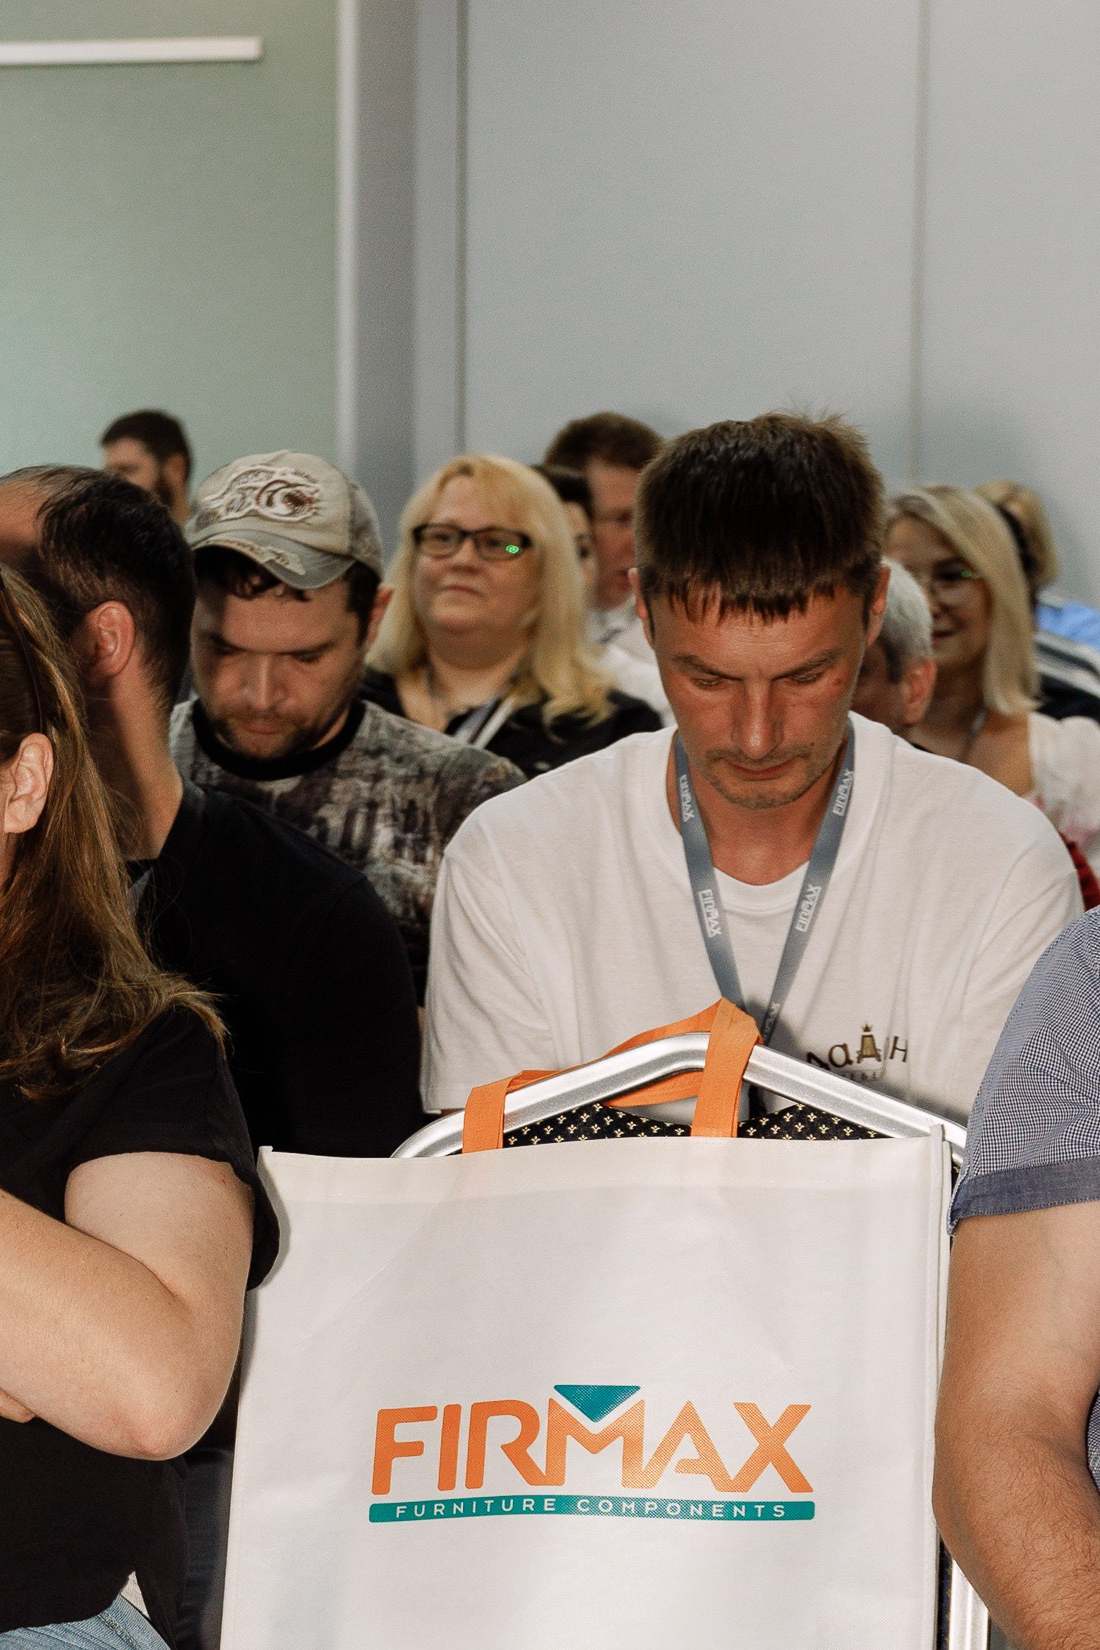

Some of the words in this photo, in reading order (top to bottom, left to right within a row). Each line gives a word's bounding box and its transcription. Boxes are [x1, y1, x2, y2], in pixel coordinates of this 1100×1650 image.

[698, 888, 723, 939] FIRMAX
[795, 883, 822, 933] FIRMAX
[371, 1385, 814, 1496] FIRMAX
[395, 1497, 557, 1519] FURNITURE
[576, 1498, 786, 1519] COMPONENTS
